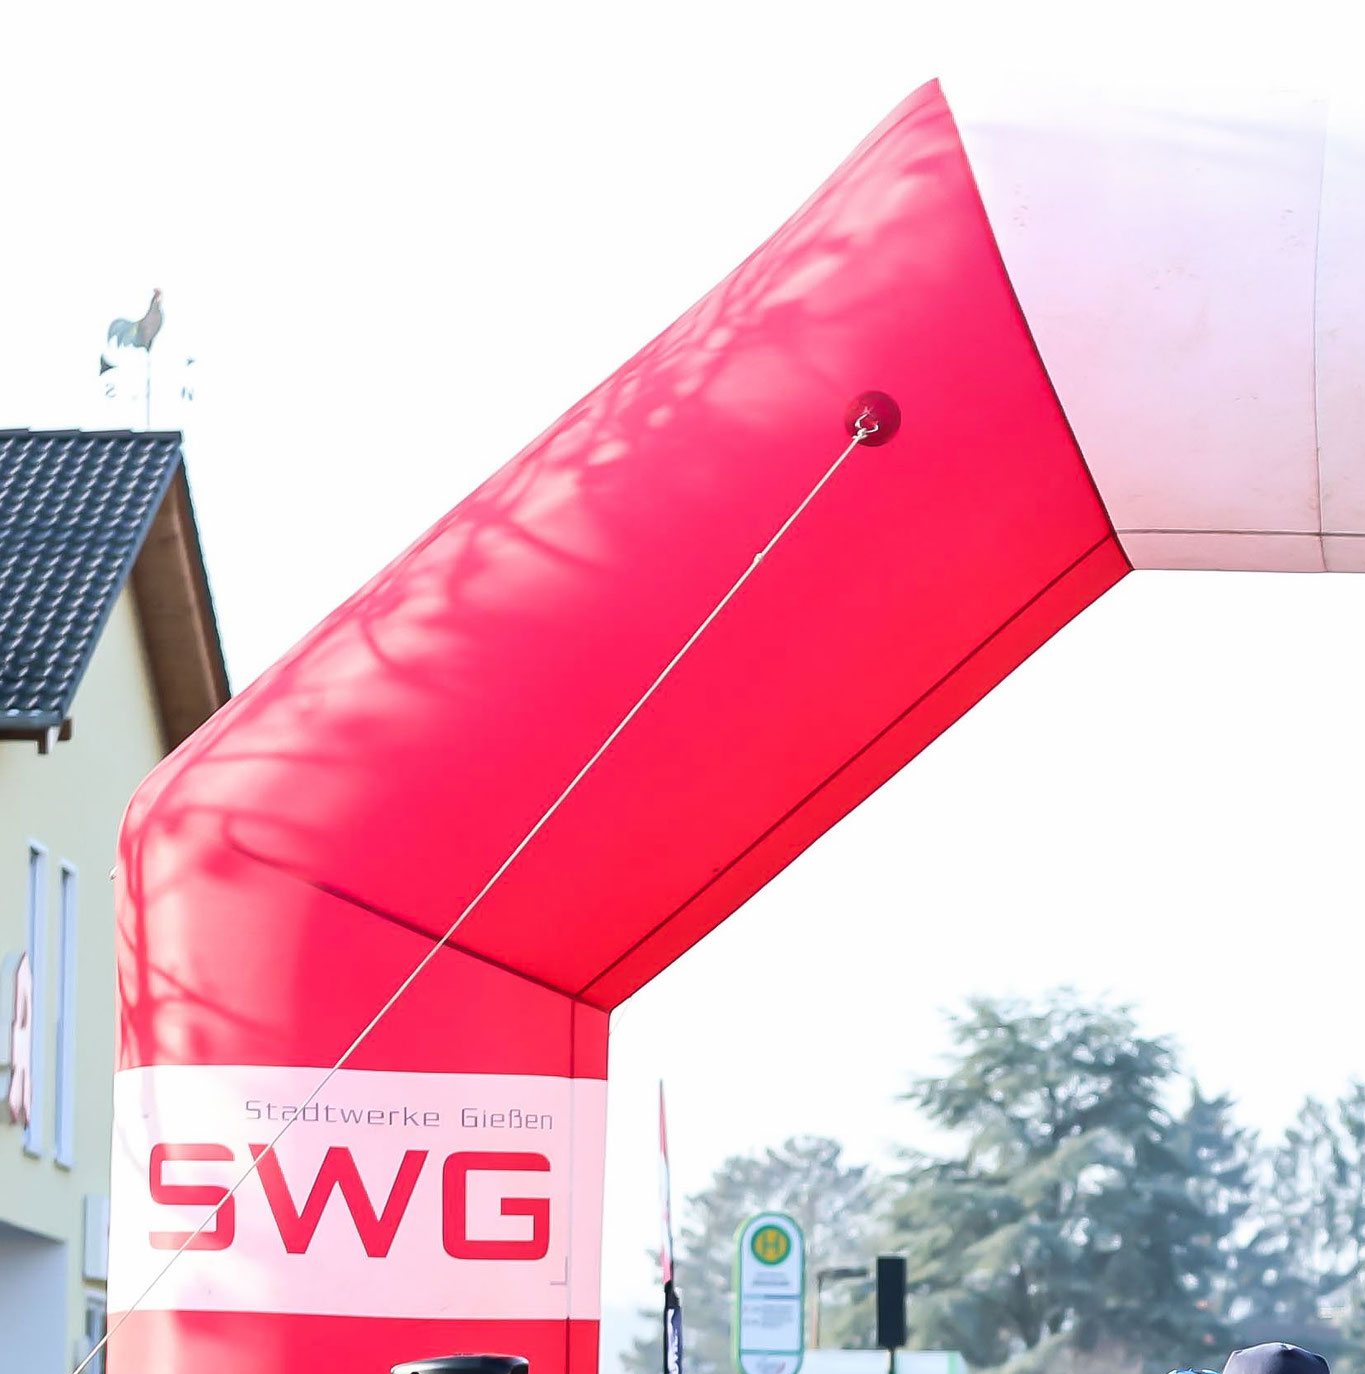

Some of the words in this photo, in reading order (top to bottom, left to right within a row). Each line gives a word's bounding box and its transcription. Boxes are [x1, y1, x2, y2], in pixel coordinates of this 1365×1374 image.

[245, 1099, 440, 1127] Stadtwerke
[461, 1106, 553, 1130] Gießen
[149, 1143, 551, 1261] SWG
